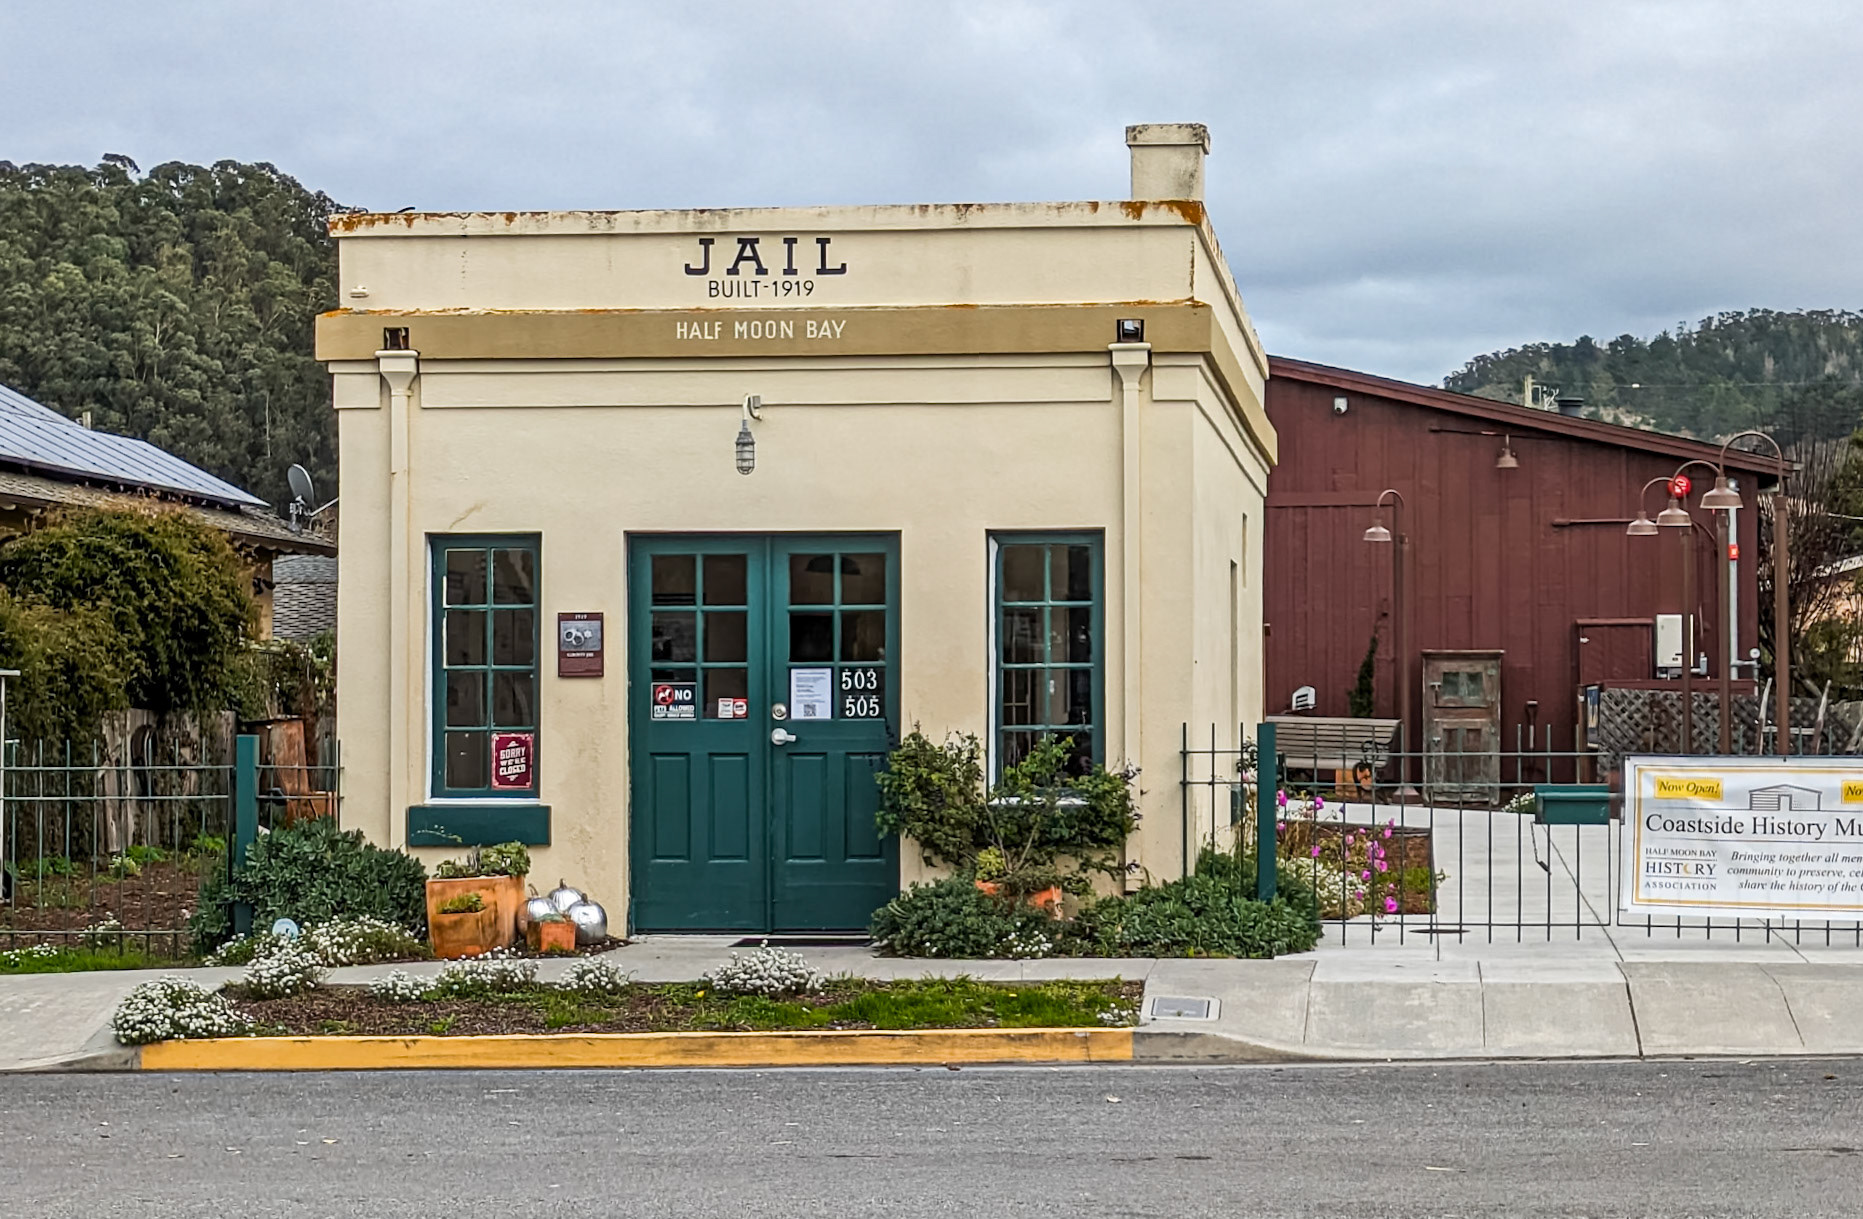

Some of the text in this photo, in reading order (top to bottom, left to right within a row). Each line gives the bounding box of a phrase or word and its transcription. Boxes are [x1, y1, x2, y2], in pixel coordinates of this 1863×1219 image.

[684, 237, 847, 276] JAIL
[708, 280, 815, 298] BUILT-1919
[676, 319, 847, 339] HALF MOON BAY
[842, 670, 877, 690] 503
[674, 689, 692, 701] NO
[845, 697, 880, 717] 505
[500, 746, 526, 760] SORRY
[499, 763, 526, 776] CLOSED
[1658, 781, 1720, 795] Now Open!
[1645, 814, 1745, 835] Coastside
[1752, 816, 1828, 840] History
[1645, 847, 1717, 858] HALF MOON BAY
[1731, 851, 1776, 864] Bringing
[1779, 851, 1822, 864] together
[1825, 852, 1840, 863] all
[1727, 866, 1784, 879] community
[1786, 867, 1797, 876] to
[1798, 868, 1845, 880] preserve,
[1645, 881, 1717, 890] ASSOCIATION
[1738, 879, 1767, 890] share
[1770, 880, 1786, 891] the
[1789, 880, 1825, 893] history
[1827, 881, 1840, 893] of
[1841, 881, 1857, 892] the
